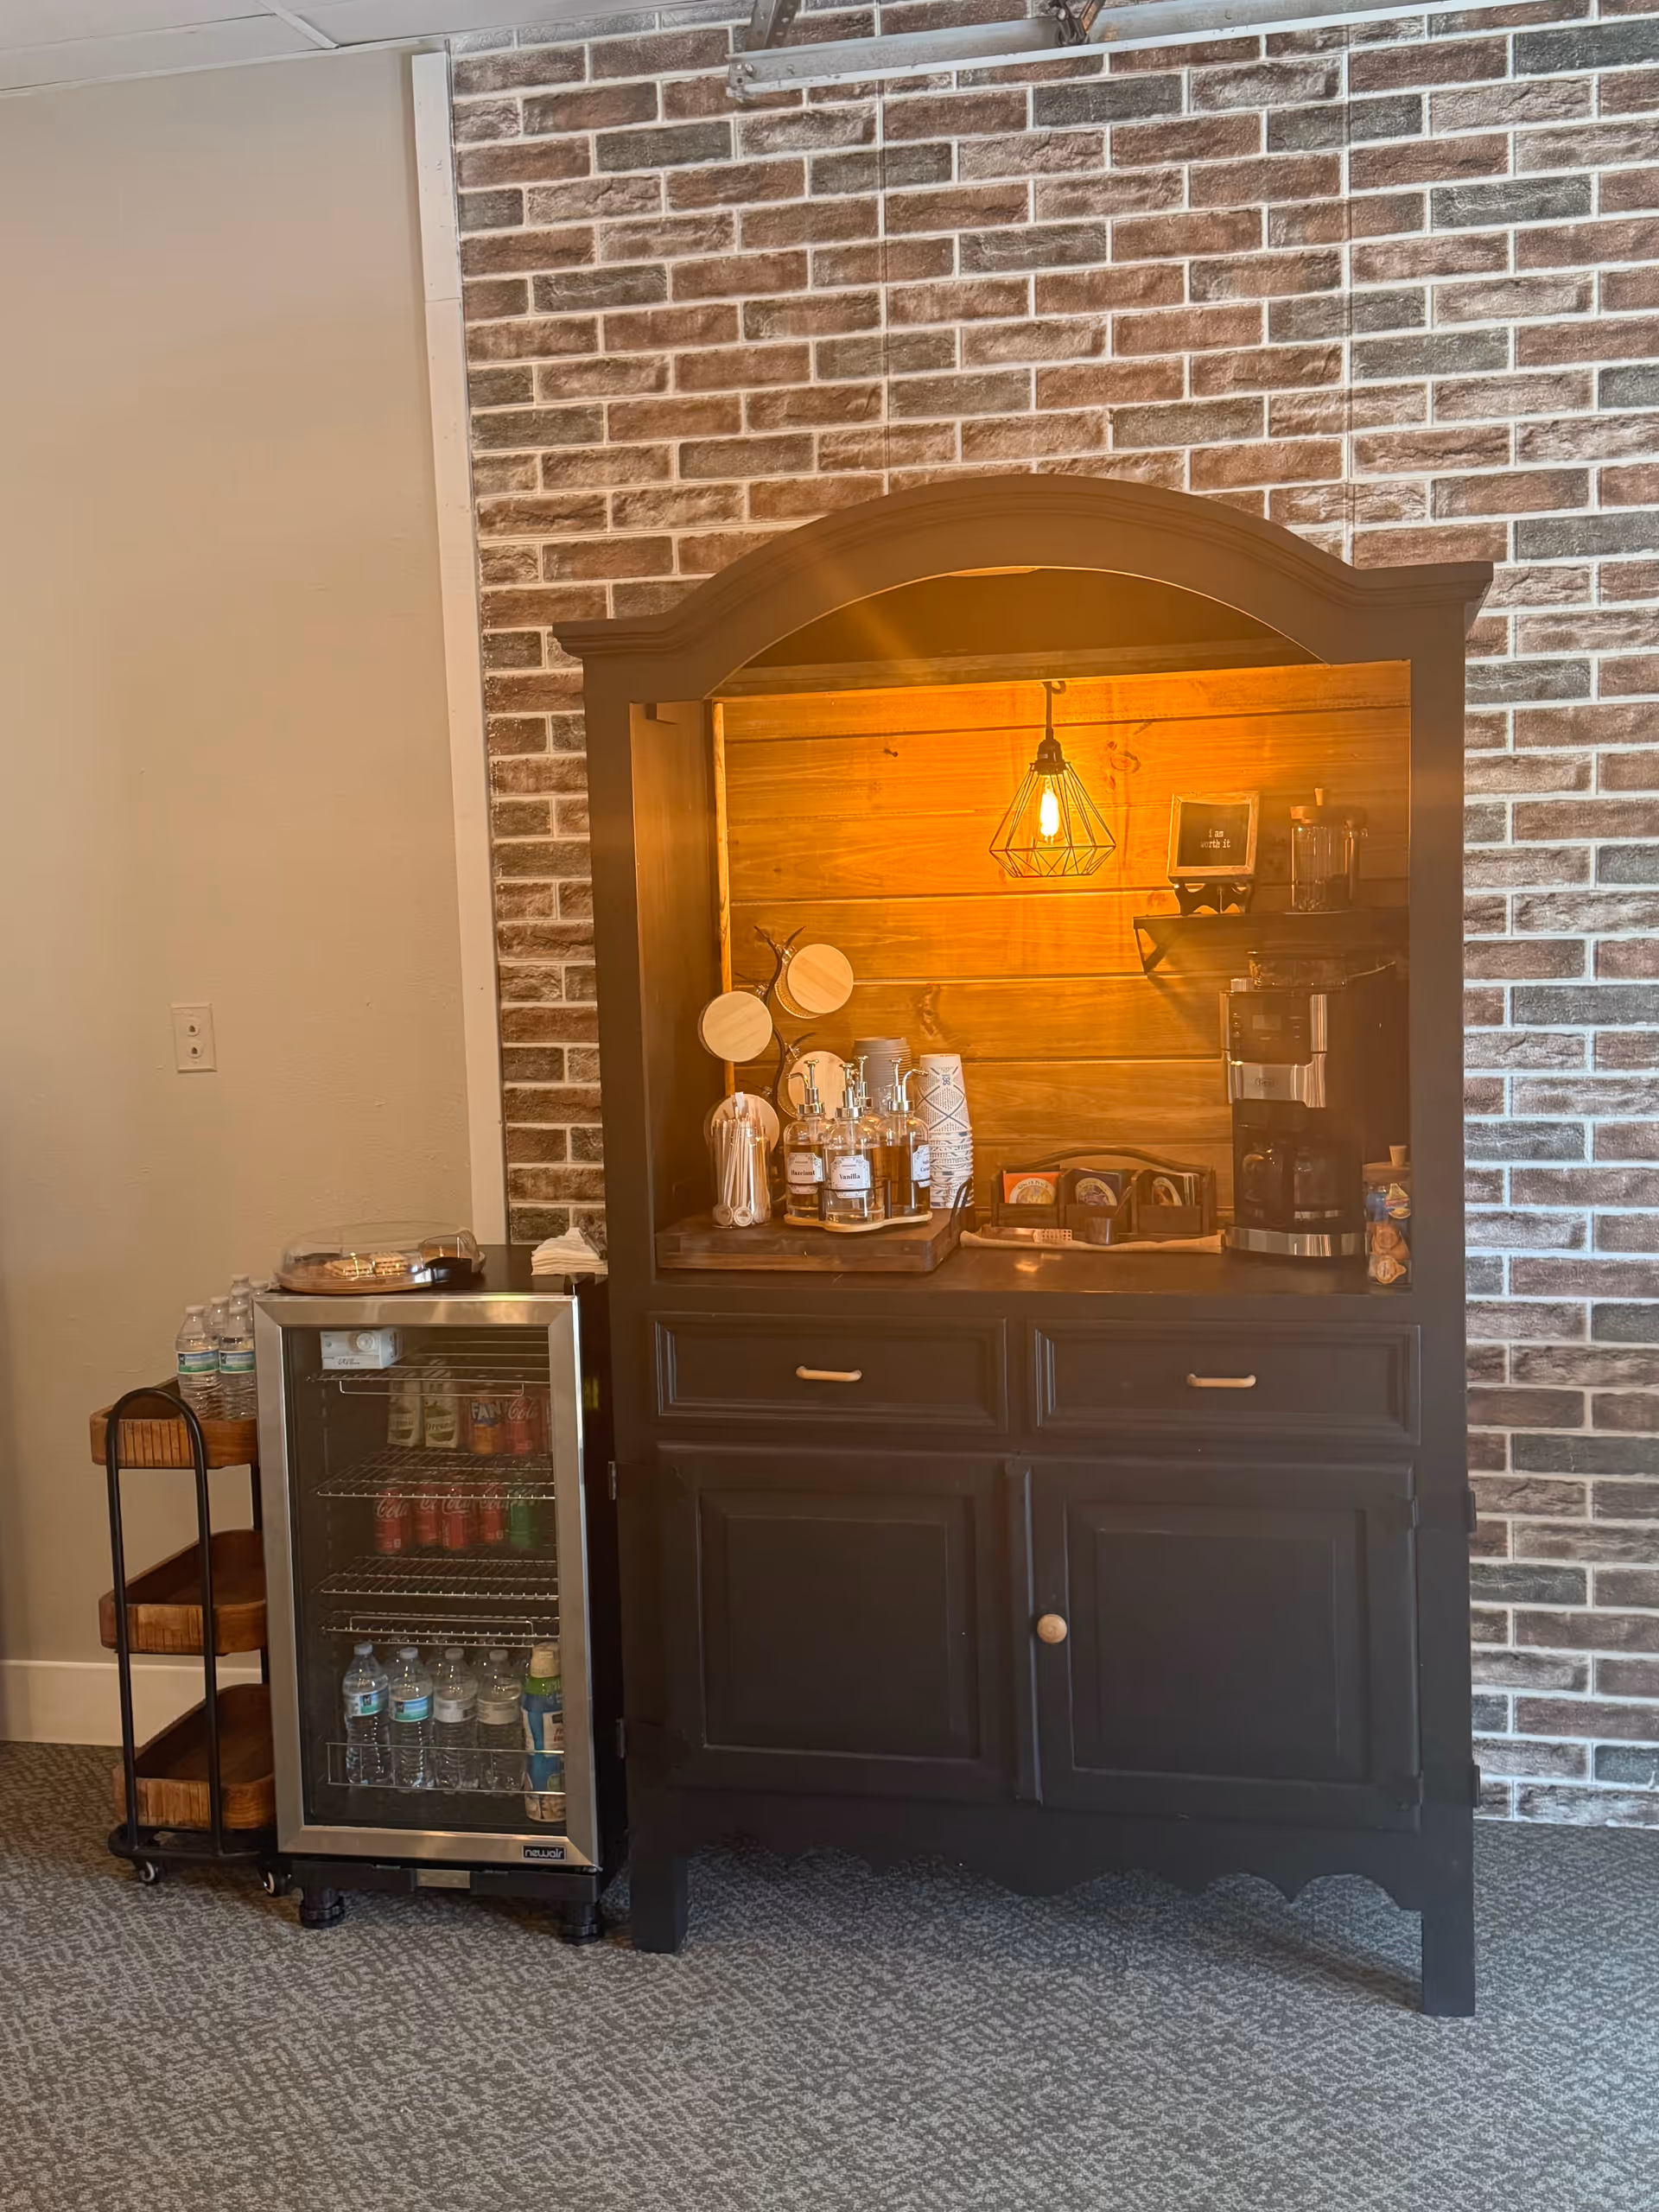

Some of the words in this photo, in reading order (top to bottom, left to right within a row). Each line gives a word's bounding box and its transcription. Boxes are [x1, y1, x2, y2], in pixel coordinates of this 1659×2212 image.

[1214, 830, 1224, 838] am
[1199, 838, 1221, 849] worth
[1222, 838, 1231, 849] it
[524, 1847, 563, 1858] newair
